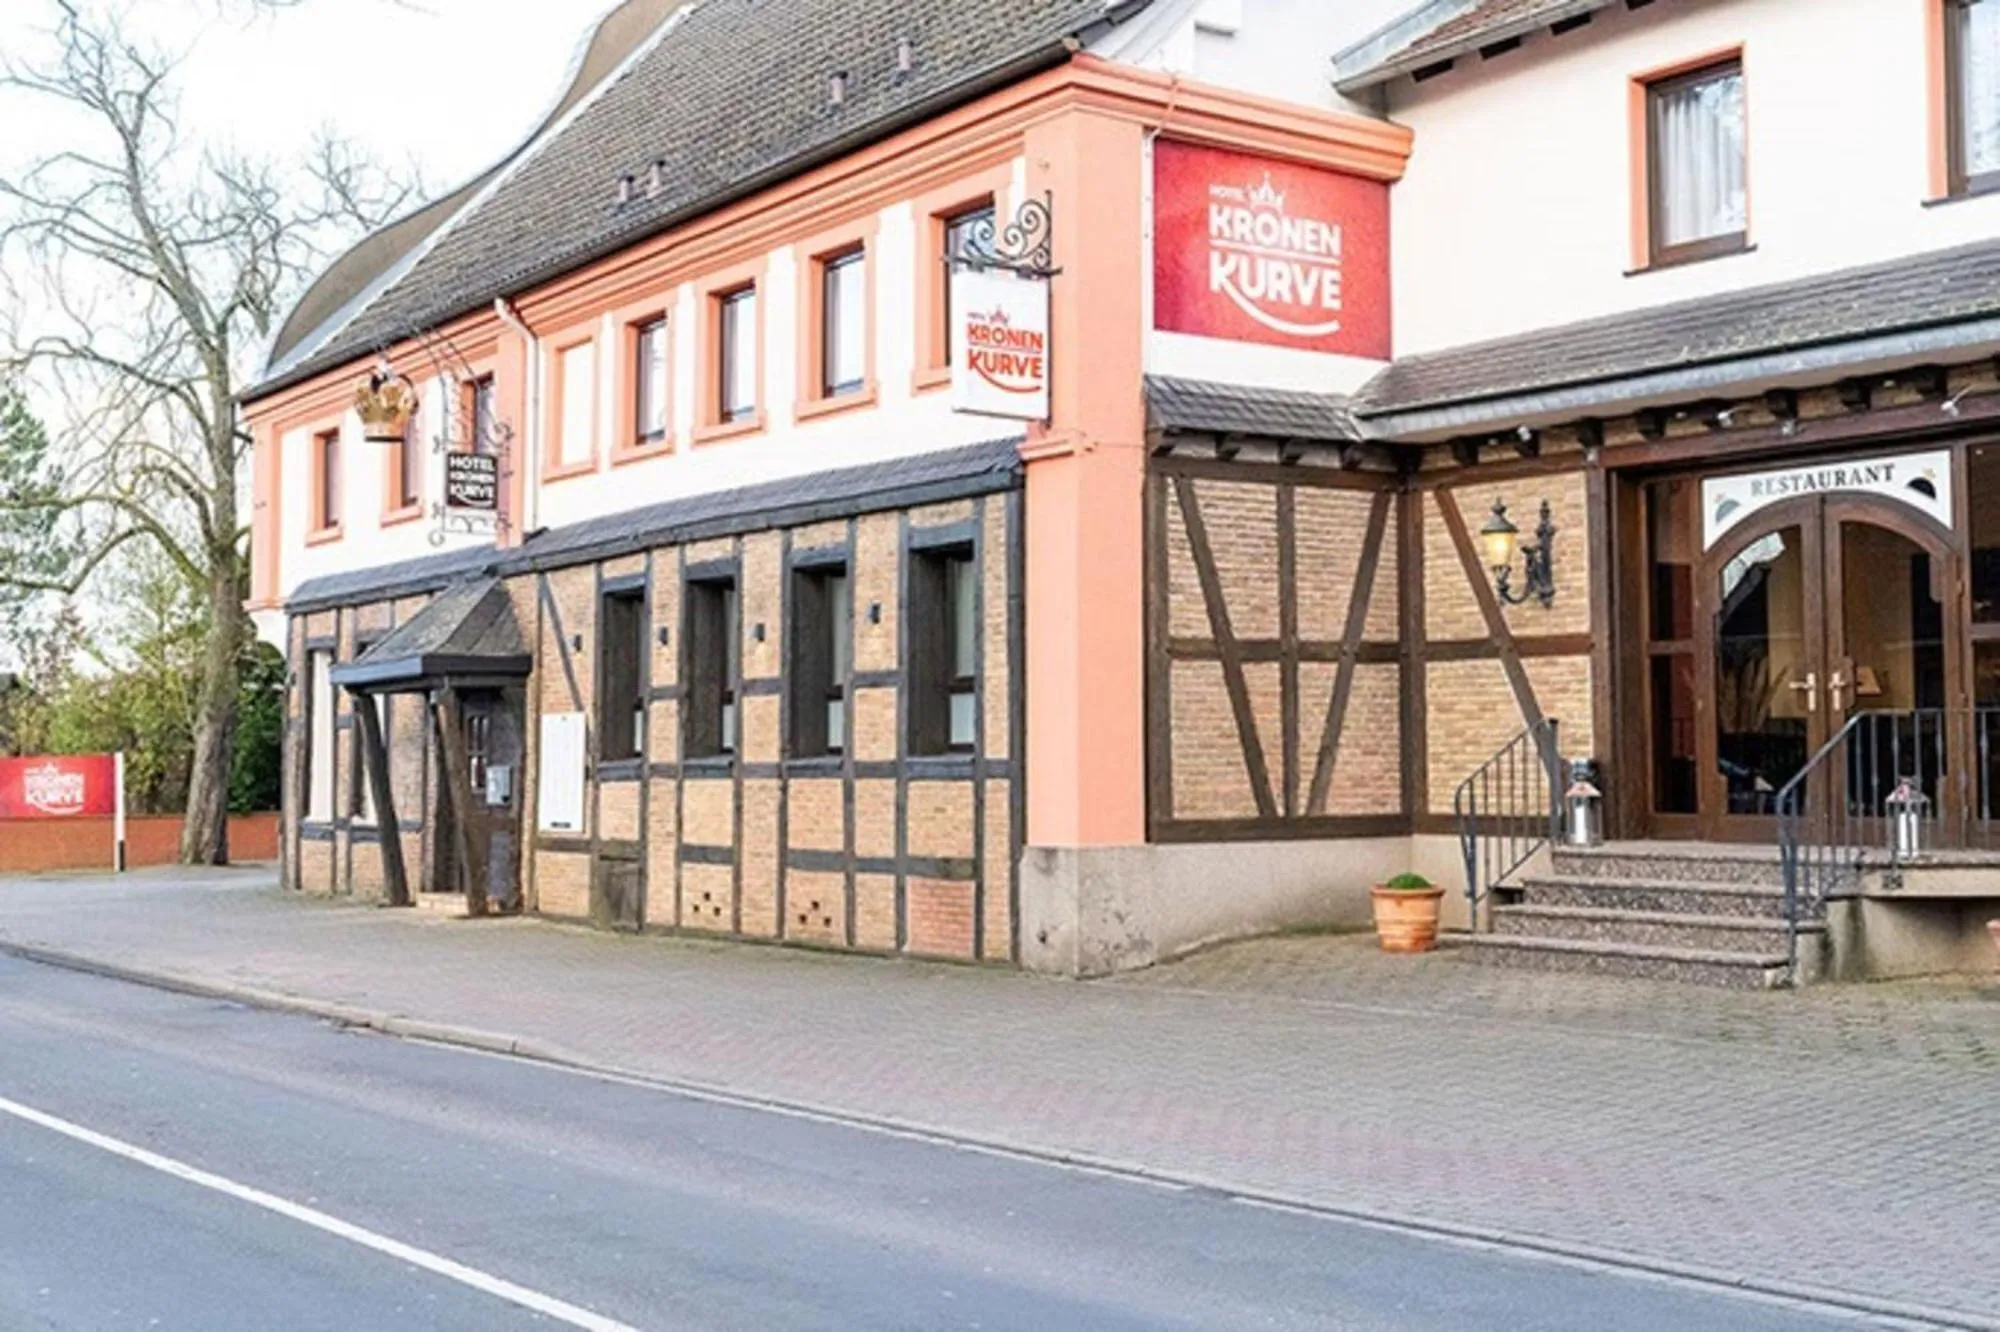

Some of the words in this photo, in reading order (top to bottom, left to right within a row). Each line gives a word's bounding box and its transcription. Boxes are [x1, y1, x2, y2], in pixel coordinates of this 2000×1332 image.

[1208, 203, 1341, 255] KRONEN
[1208, 251, 1342, 336] KURVE
[967, 323, 1043, 349] KRONEN
[967, 349, 1043, 393] KURVE
[450, 456, 495, 472] HOTEL
[1751, 463, 1895, 497] RESTAURANT
[450, 483, 494, 507] KURVE
